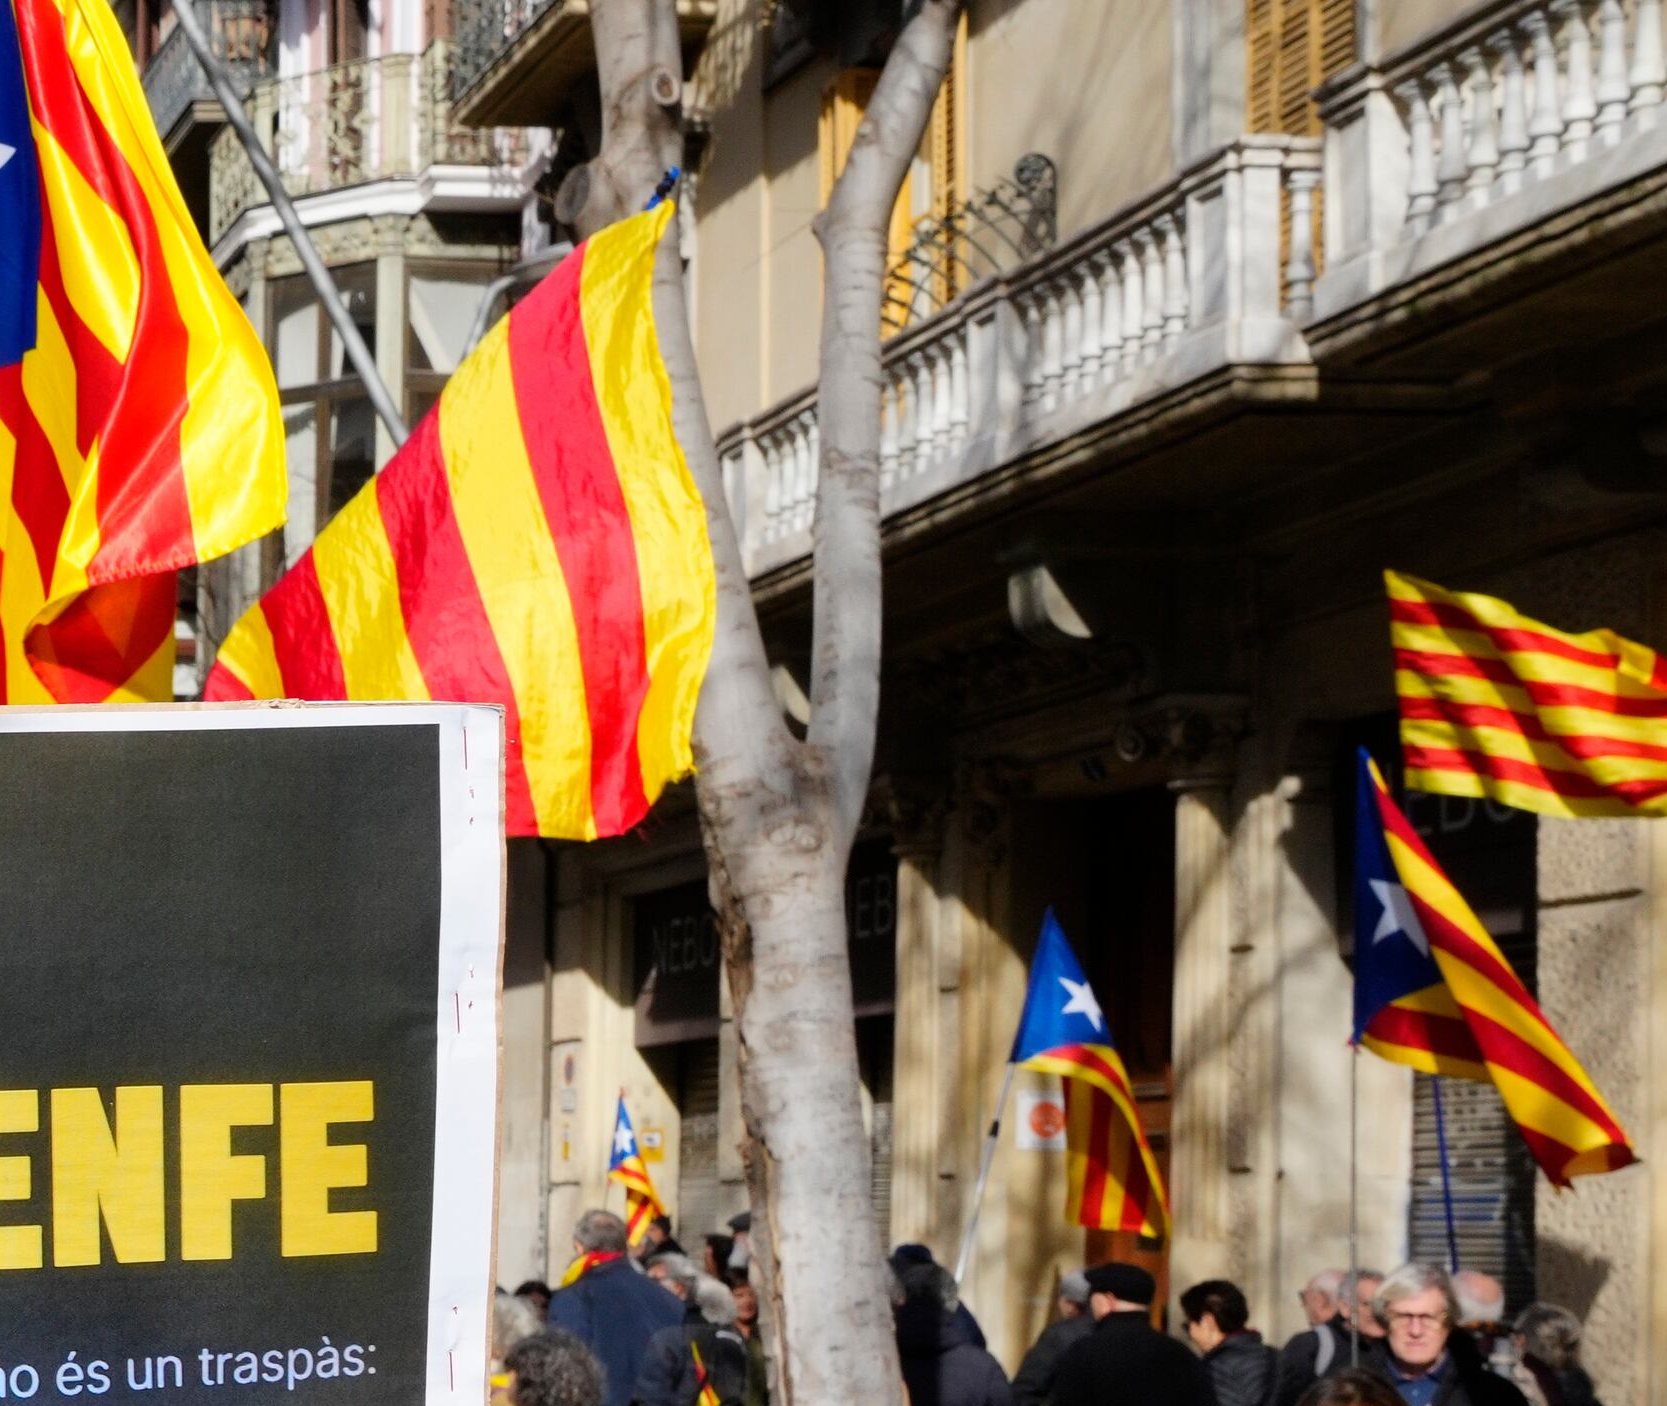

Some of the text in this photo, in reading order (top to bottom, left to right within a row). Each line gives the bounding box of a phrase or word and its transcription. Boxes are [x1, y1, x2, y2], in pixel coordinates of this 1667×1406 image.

[56, 1351, 111, 1396] és
[127, 1354, 184, 1391] un
[198, 1336, 377, 1390] traspàs:
